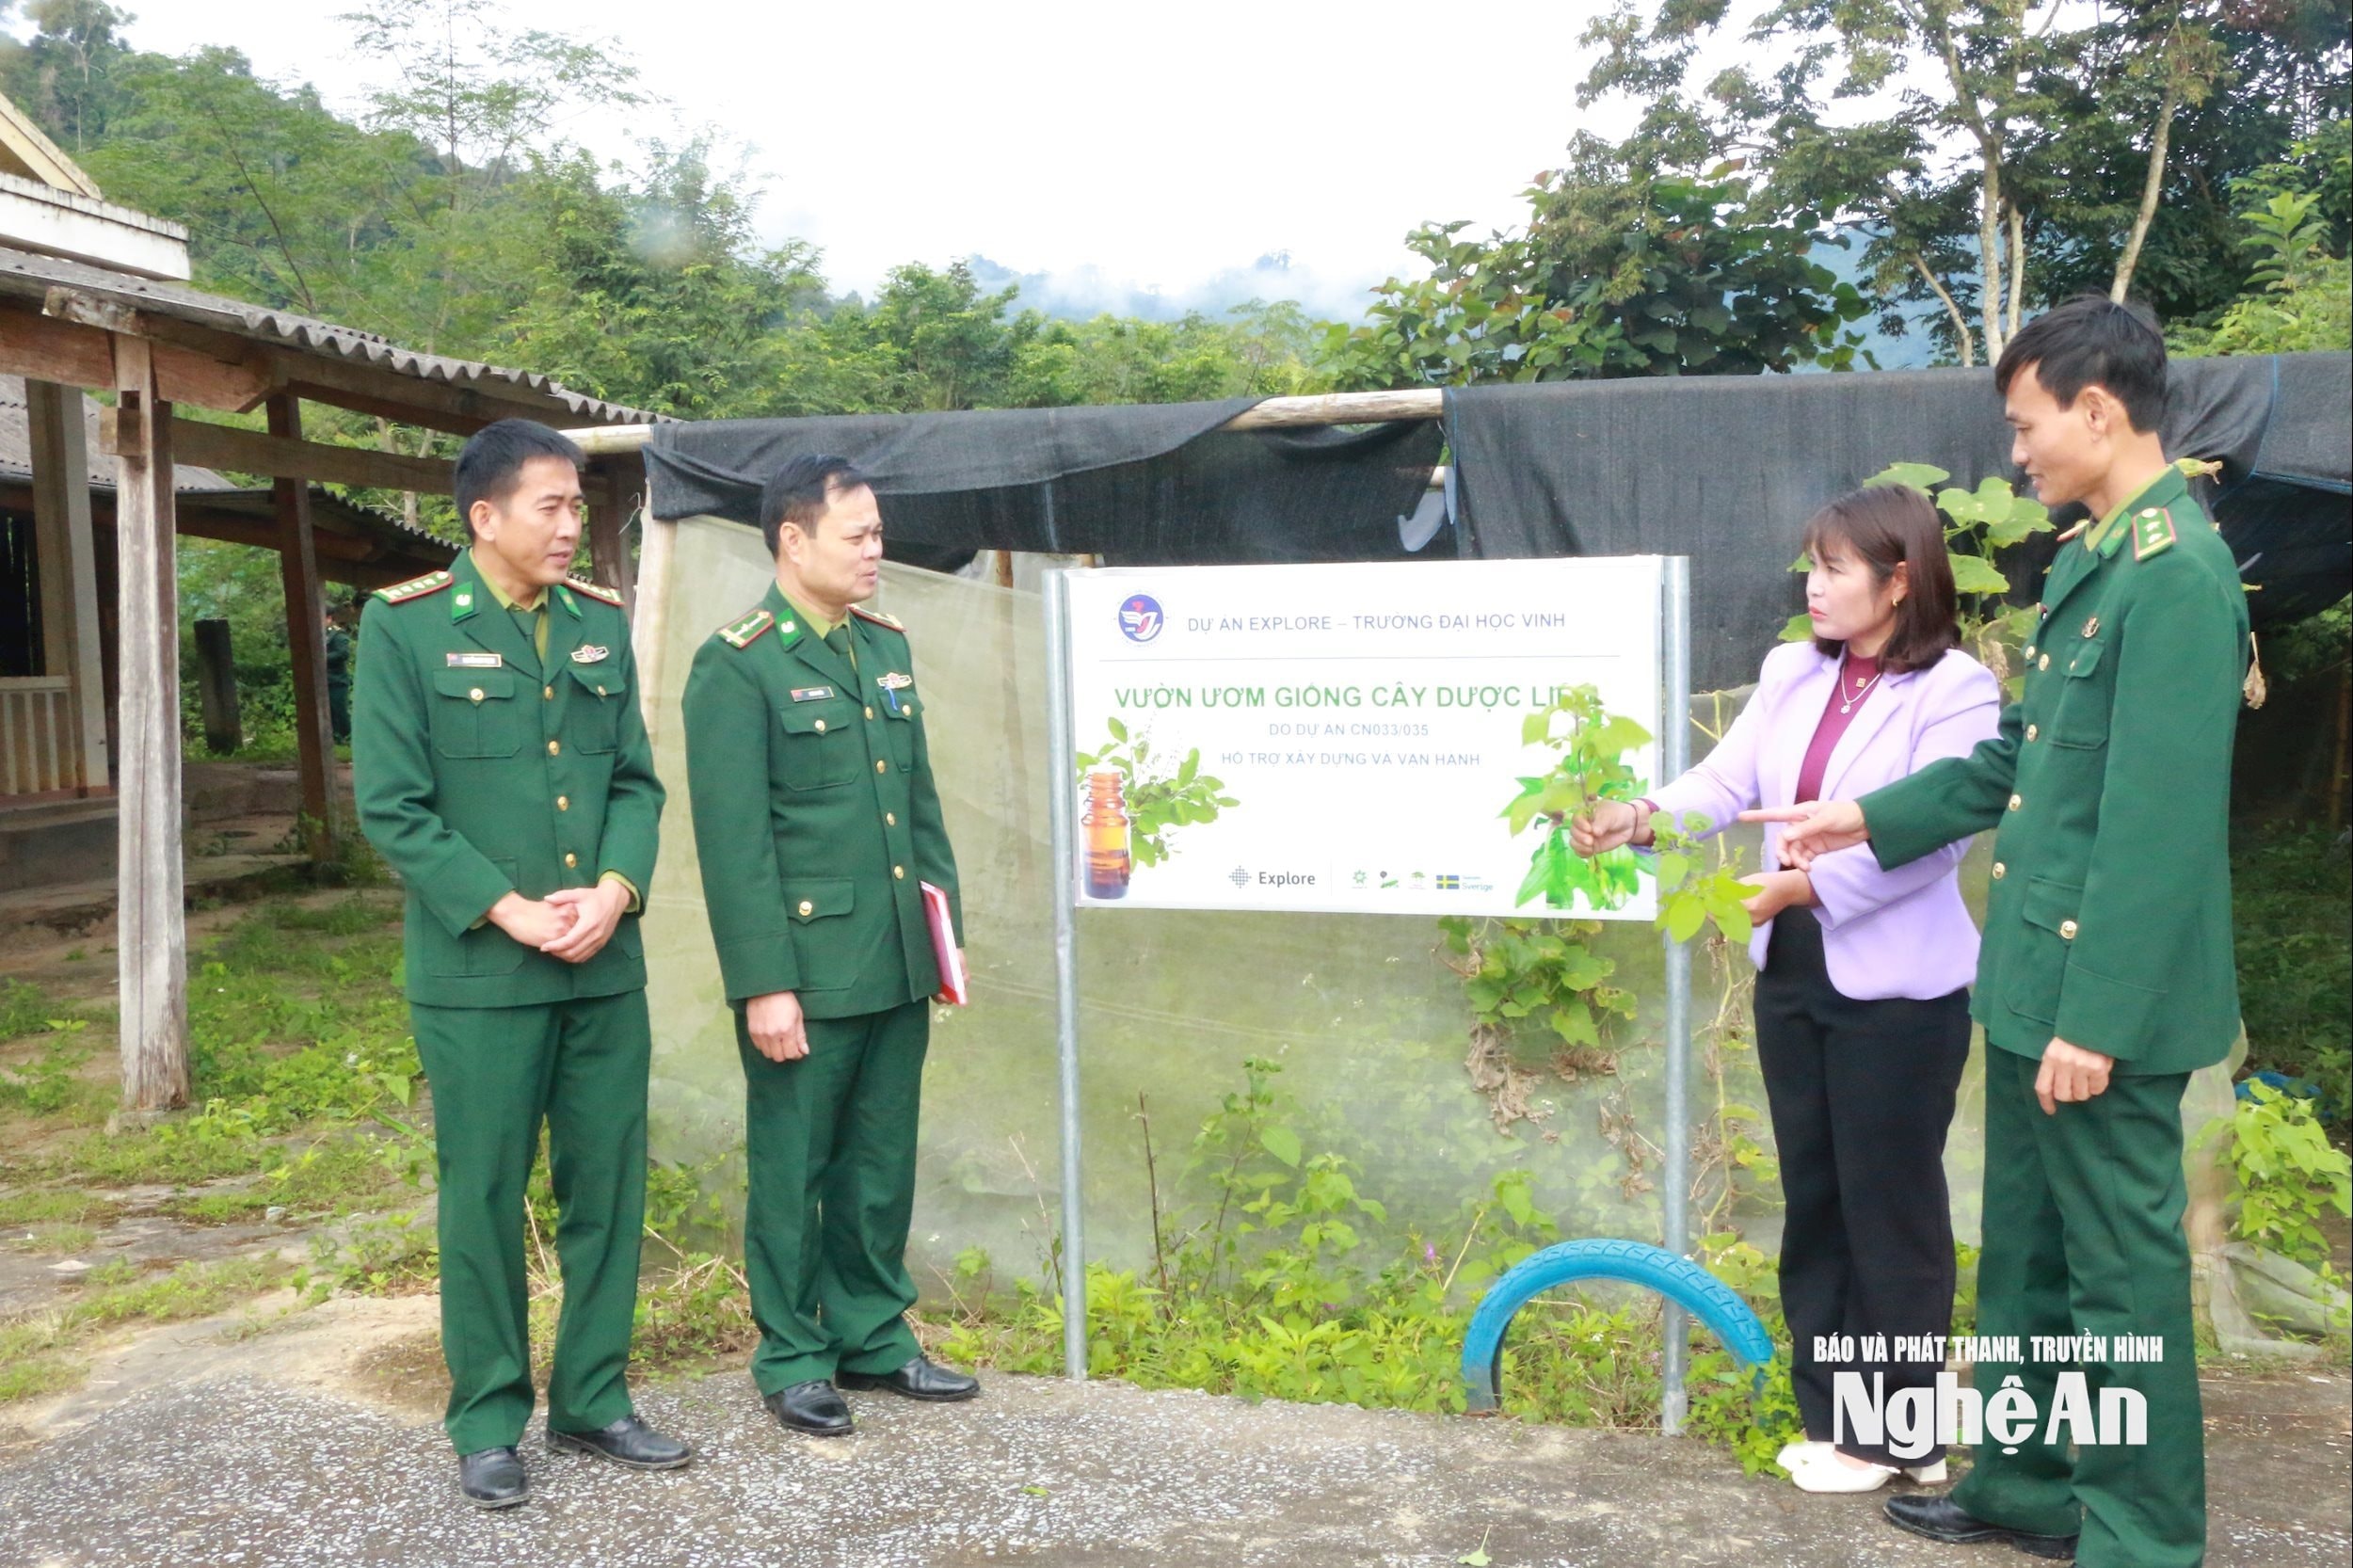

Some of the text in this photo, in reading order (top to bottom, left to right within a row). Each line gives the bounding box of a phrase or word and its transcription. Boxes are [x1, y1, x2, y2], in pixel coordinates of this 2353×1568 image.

[1249, 616, 1332, 631] EXPLORE
[1439, 615, 1469, 632] ĐẠI
[1476, 614, 1514, 632] HỌC
[1522, 613, 1565, 628] VINH
[1114, 682, 1193, 708] VƯỜN
[1202, 686, 1265, 708] ƯƠM
[1371, 680, 1427, 707] CÂY
[1437, 686, 1521, 713] DƯỢC
[1270, 723, 1291, 736] DO
[1351, 723, 1429, 737] CN033/035
[1258, 871, 1316, 887] Explore
